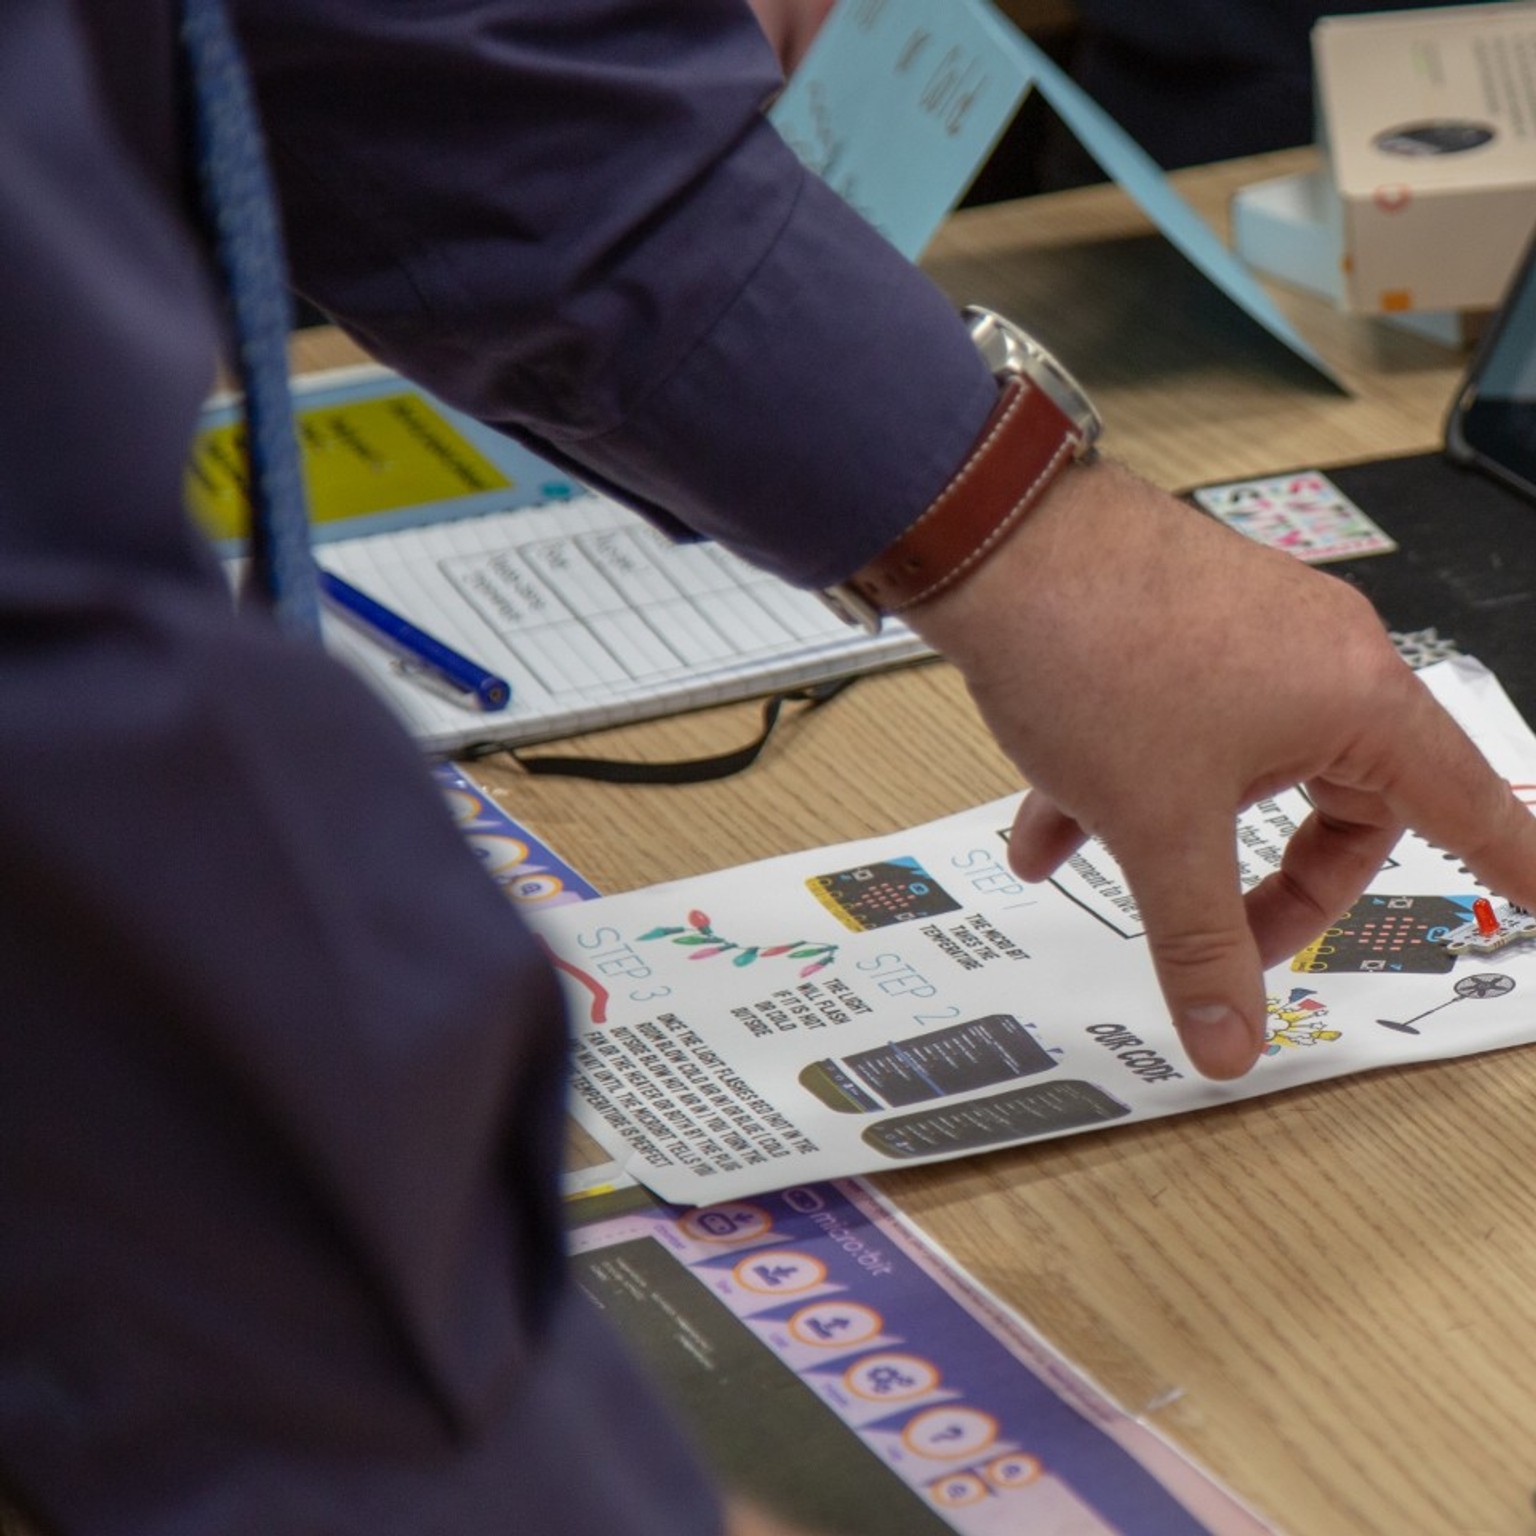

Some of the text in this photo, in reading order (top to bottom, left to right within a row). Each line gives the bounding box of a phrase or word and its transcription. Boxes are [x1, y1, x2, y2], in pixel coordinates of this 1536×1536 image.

[951, 849, 1025, 895] STEP
[966, 914, 992, 930] THE
[920, 925, 983, 970] TEMPERATURE
[976, 946, 1000, 960] THE
[577, 926, 672, 1002] STEP 3
[781, 997, 802, 1005] IT
[797, 983, 851, 1024] WILL FLASH
[824, 979, 871, 1014] THE LIGHT
[856, 953, 961, 1026] STEP 2
[731, 1007, 773, 1037] OUTSIDE
[755, 1001, 797, 1031] OR COLD
[790, 1005, 810, 1014] IS
[799, 1013, 826, 1029] HOT
[637, 1022, 667, 1042] ROOM
[655, 1041, 688, 1063] BLOW
[1085, 1023, 1184, 1083] OUR CODE
[657, 1014, 687, 1031] ONCE
[678, 1030, 703, 1046] THE
[691, 1046, 726, 1068] LIGHT
[714, 1068, 758, 1100] FLASHES
[748, 1100, 774, 1114] RED
[793, 1138, 818, 1153] THE
[677, 1063, 709, 1084] COLD
[581, 1032, 607, 1046] FAN
[598, 1045, 620, 1056] OR
[610, 1055, 636, 1071] THE
[625, 1071, 664, 1099] HEATER
[653, 1099, 675, 1110] OR
[664, 1110, 694, 1128] BOTH
[684, 1128, 706, 1138] BY
[697, 1139, 723, 1155] THE
[610, 1027, 651, 1055] OUTSIDE
[639, 1055, 672, 1077] BLOW
[662, 1077, 689, 1092] HOT
[680, 1093, 701, 1105] AIR
[691, 1105, 708, 1113] IN
[721, 1131, 751, 1151] TURN
[741, 1149, 767, 1164] THE
[700, 1084, 721, 1095] AIR
[571, 1075, 673, 1167] TEMPERATURE IS PERFECT
[592, 1070, 624, 1093] UNTIL
[616, 1092, 643, 1108] THE
[631, 1108, 677, 1140] MICROBIT
[667, 1141, 702, 1164] TELLS
[722, 1106, 744, 1116] OR
[732, 1115, 765, 1135] BLUE
[759, 1138, 790, 1157] COLD
